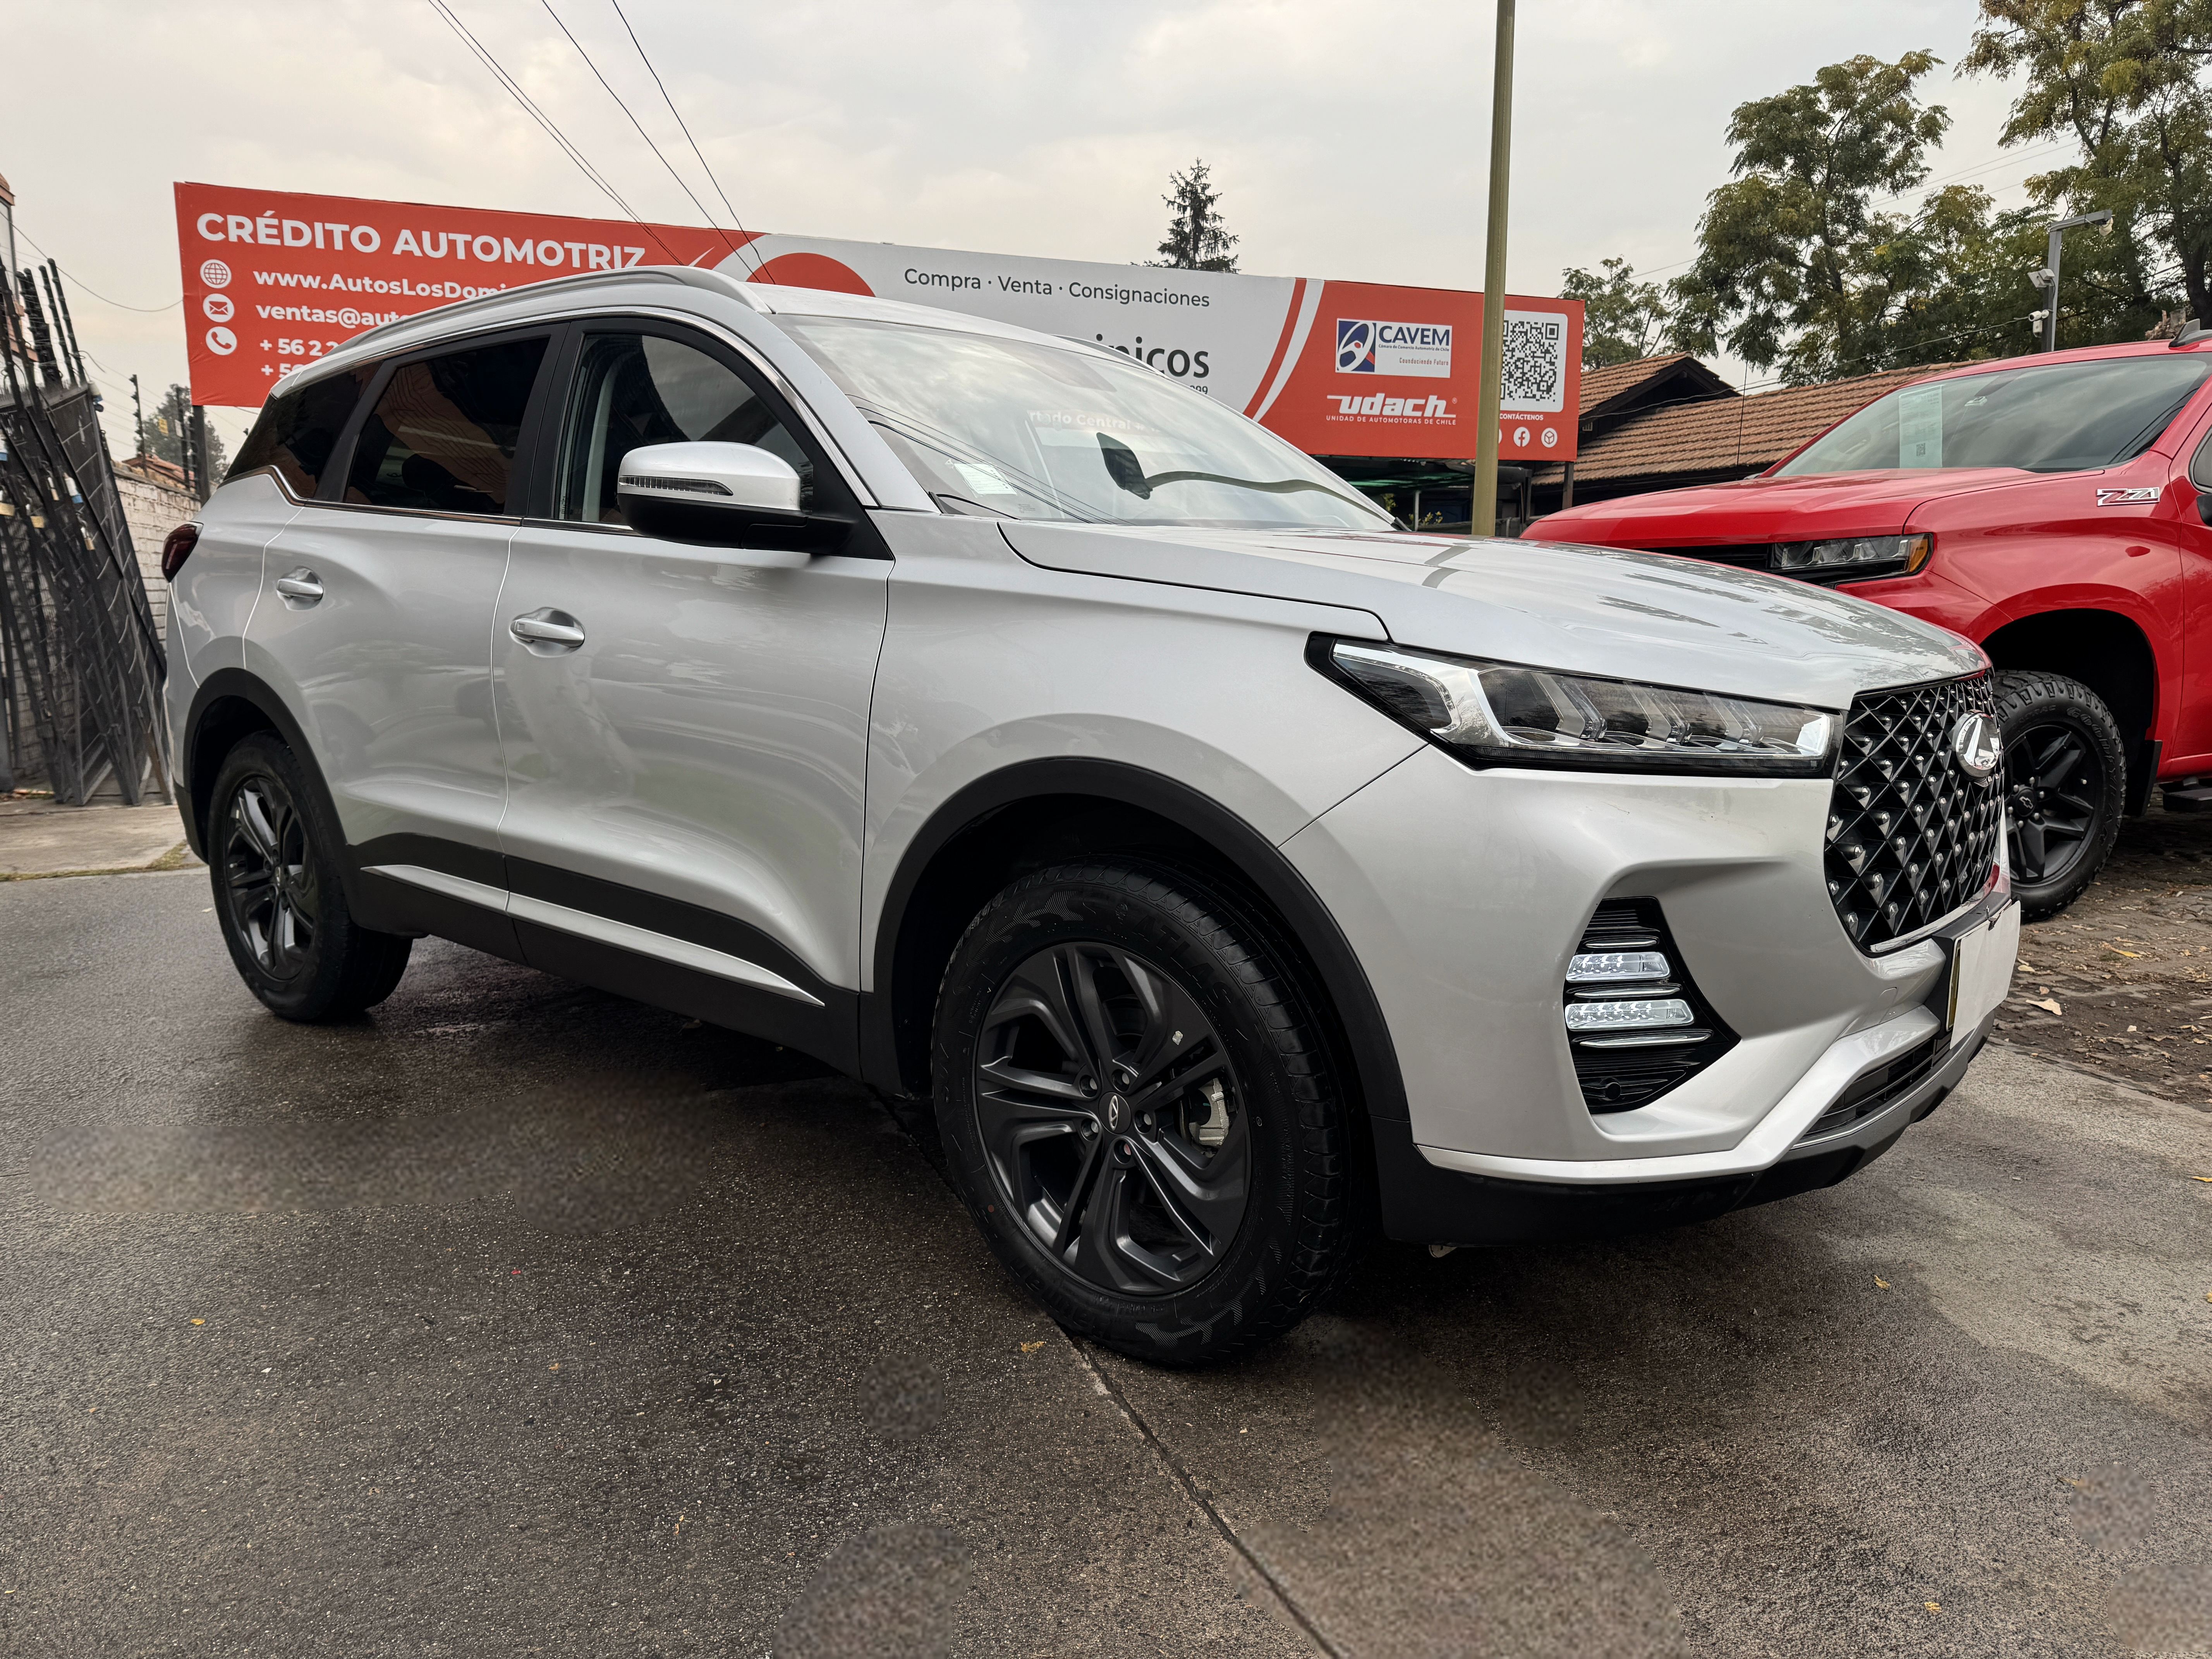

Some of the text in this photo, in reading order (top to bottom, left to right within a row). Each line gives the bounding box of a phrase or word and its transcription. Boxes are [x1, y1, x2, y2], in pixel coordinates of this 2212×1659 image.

[197, 210, 645, 270] CRÉDITO AUTOMOTRIZ
[905, 268, 1209, 307] Compra Venta Consignaciones
[256, 305, 410, 329] ventas@aut
[278, 338, 305, 355] 56
[308, 340, 323, 356] 2
[1379, 326, 1449, 346] CAVEM
[1327, 393, 1456, 418] udach
[1076, 414, 1131, 430] Central
[1131, 914, 1233, 1008] ATLAS
